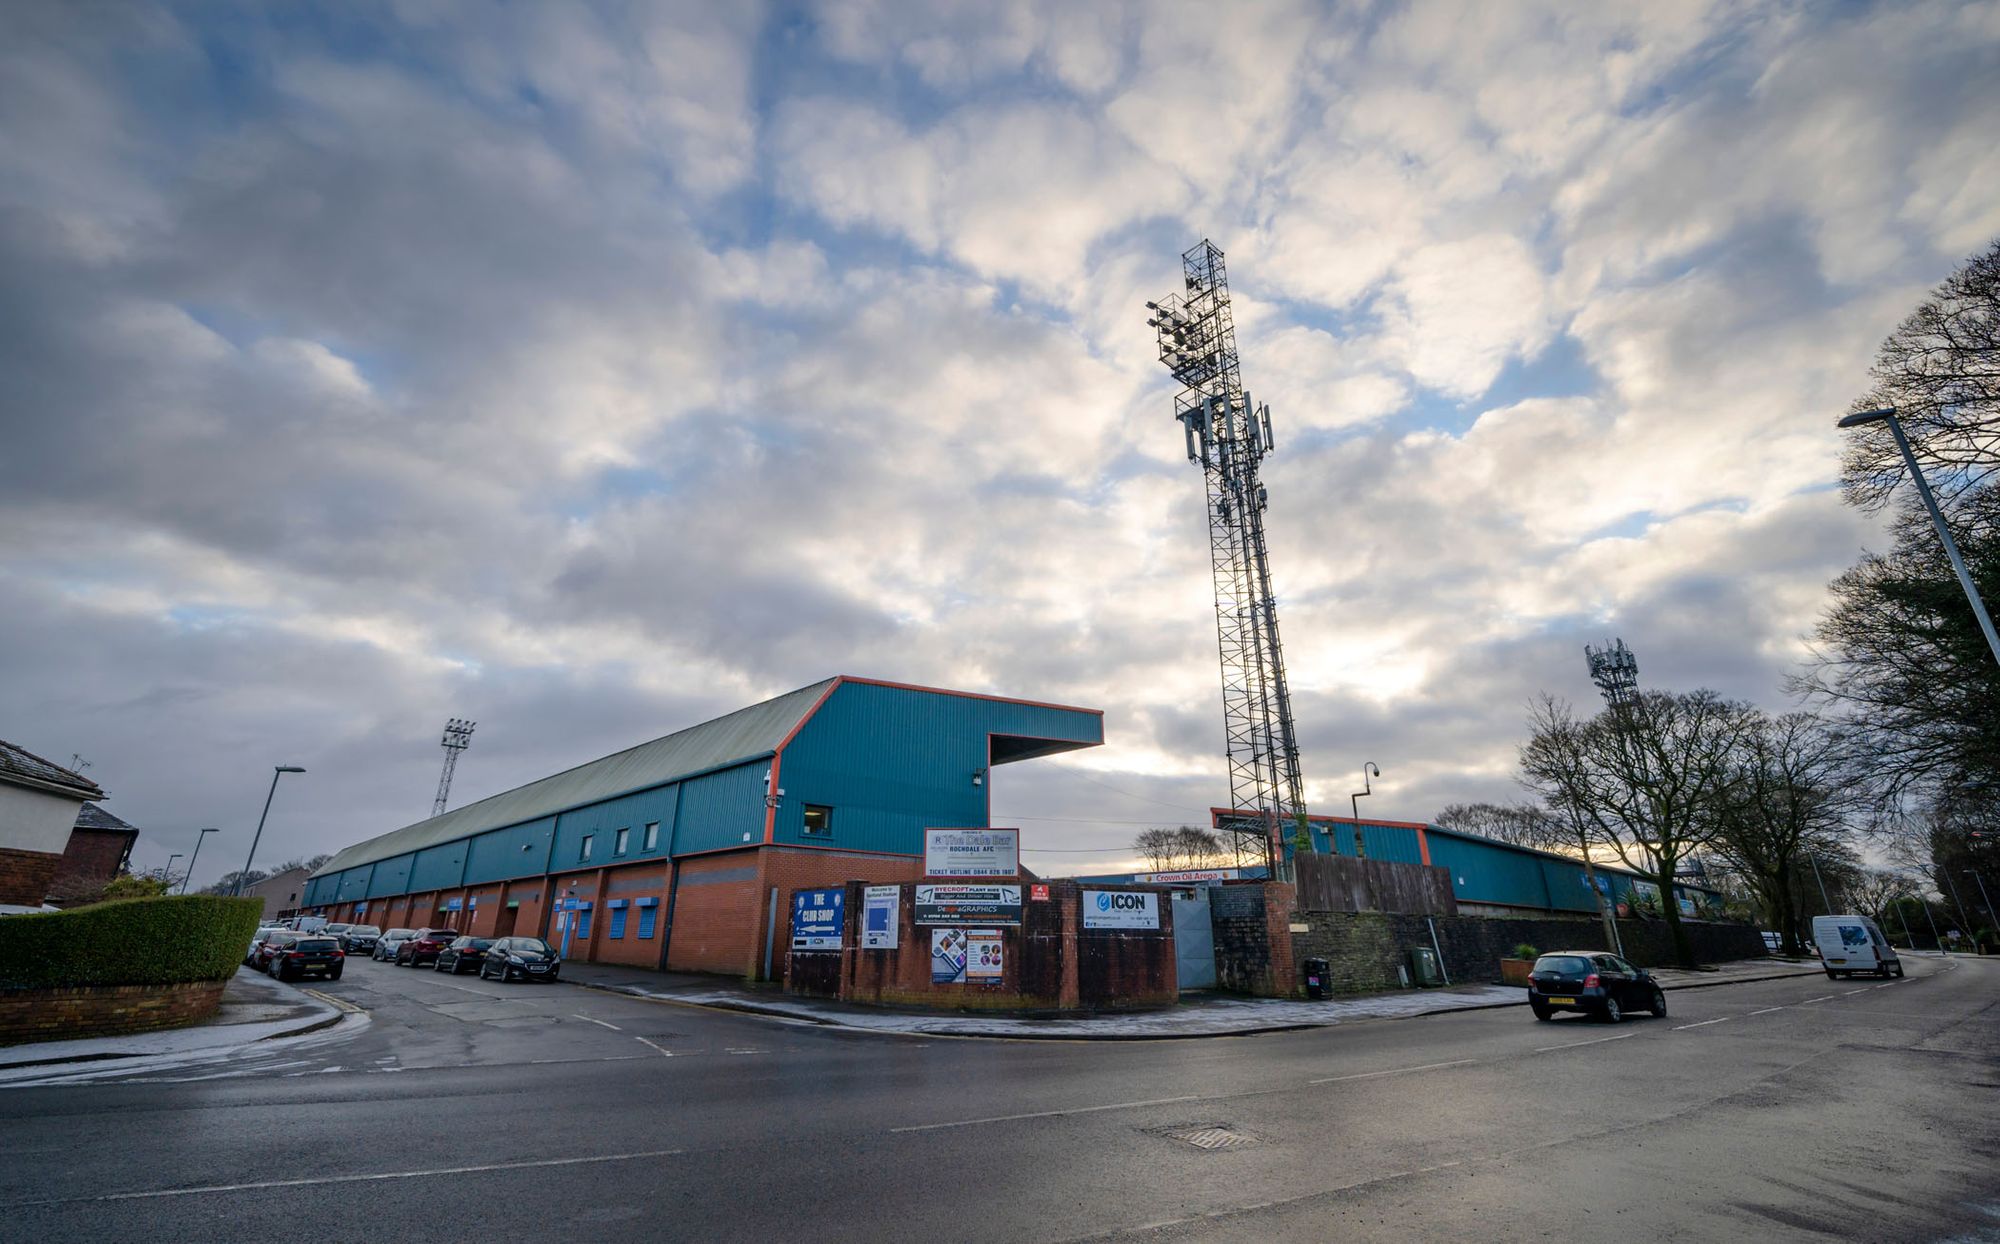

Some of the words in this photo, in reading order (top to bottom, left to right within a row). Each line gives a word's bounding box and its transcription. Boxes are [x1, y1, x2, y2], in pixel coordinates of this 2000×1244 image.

[965, 834, 990, 845] Dale
[992, 834, 1011, 845] Bar
[1156, 874, 1181, 882] Crown
[1194, 872, 1218, 880] Arena
[814, 893, 825, 905] THE
[1111, 894, 1145, 910] ICON
[803, 910, 817, 922] CLUB
[818, 909, 834, 922] SHOP
